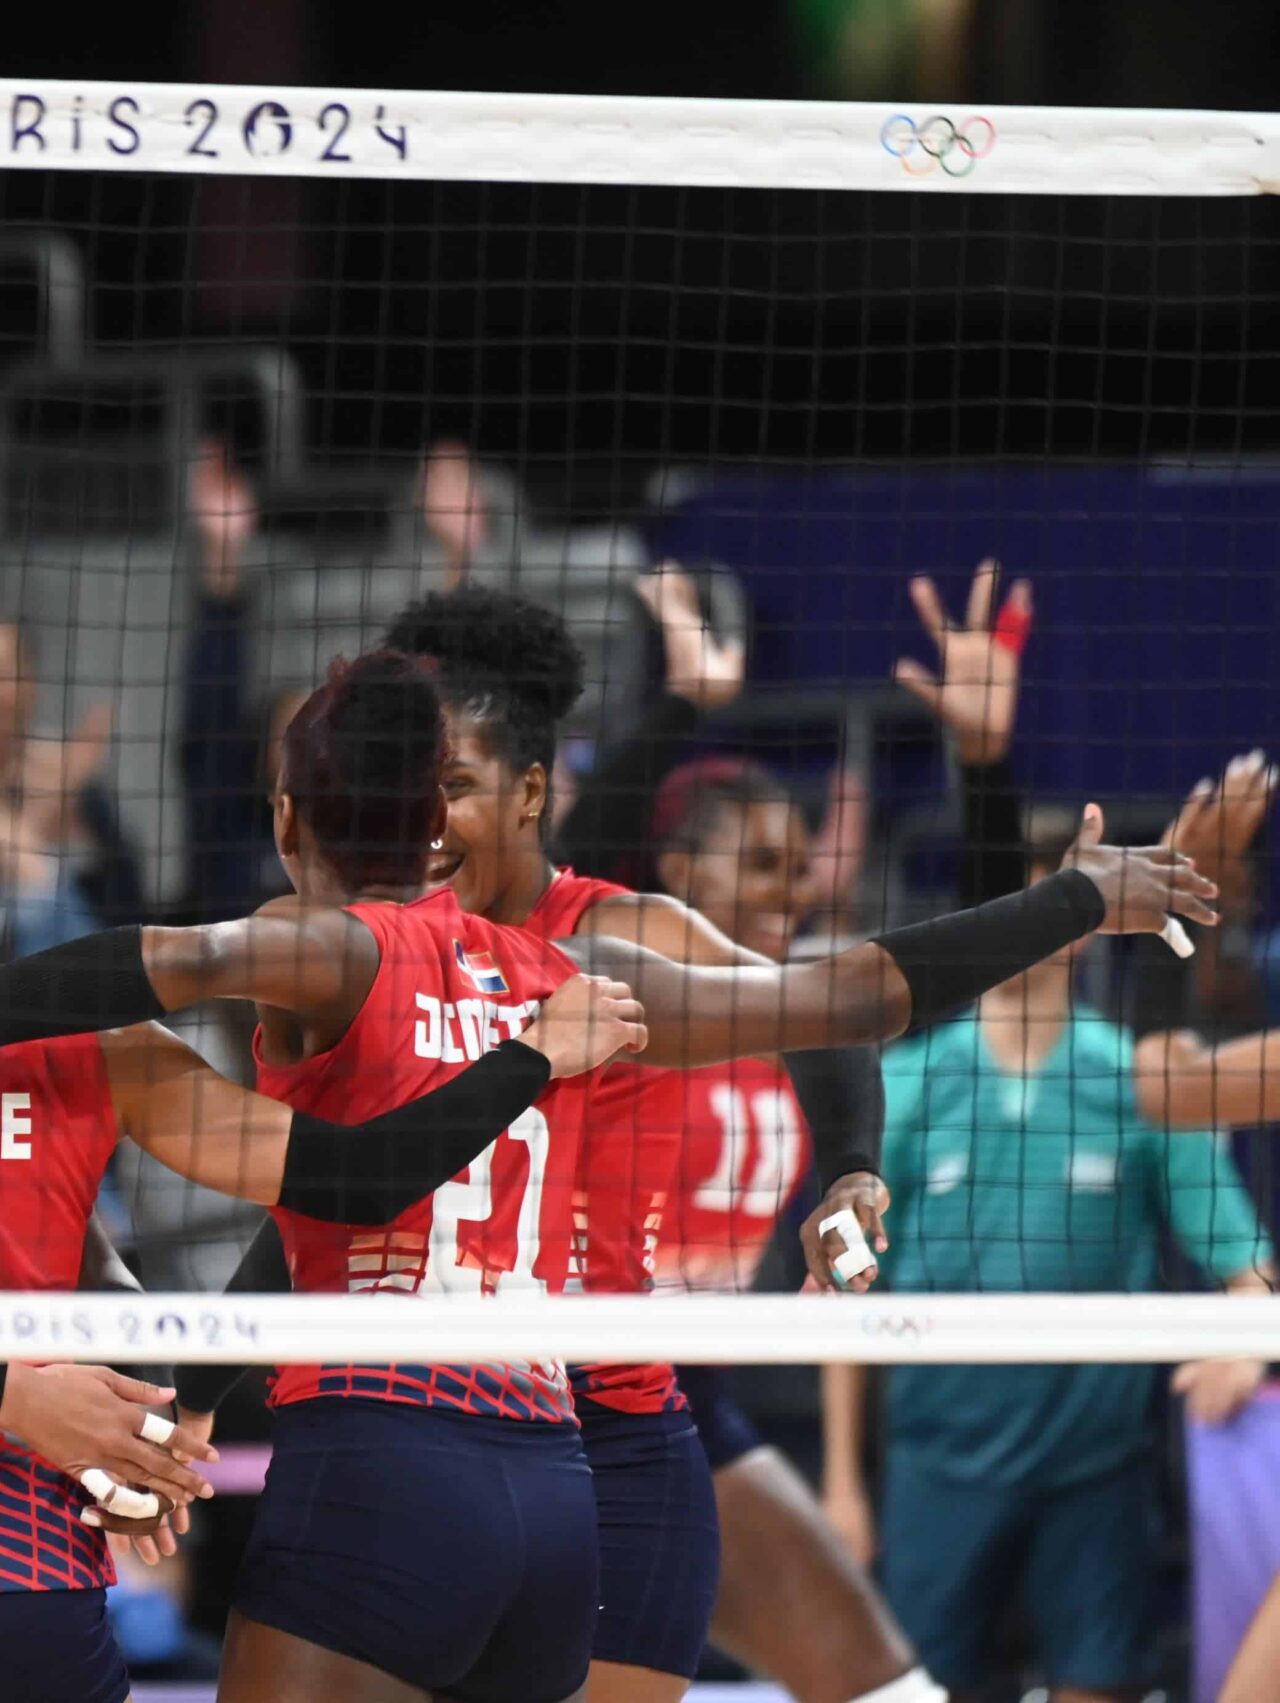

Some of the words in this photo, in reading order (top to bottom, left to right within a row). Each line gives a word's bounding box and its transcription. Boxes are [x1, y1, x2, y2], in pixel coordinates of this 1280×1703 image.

[183, 98, 408, 162] 2024
[692, 1082, 803, 1218] 11
[422, 1105, 550, 1297] 21
[117, 1311, 258, 1346] 2024
